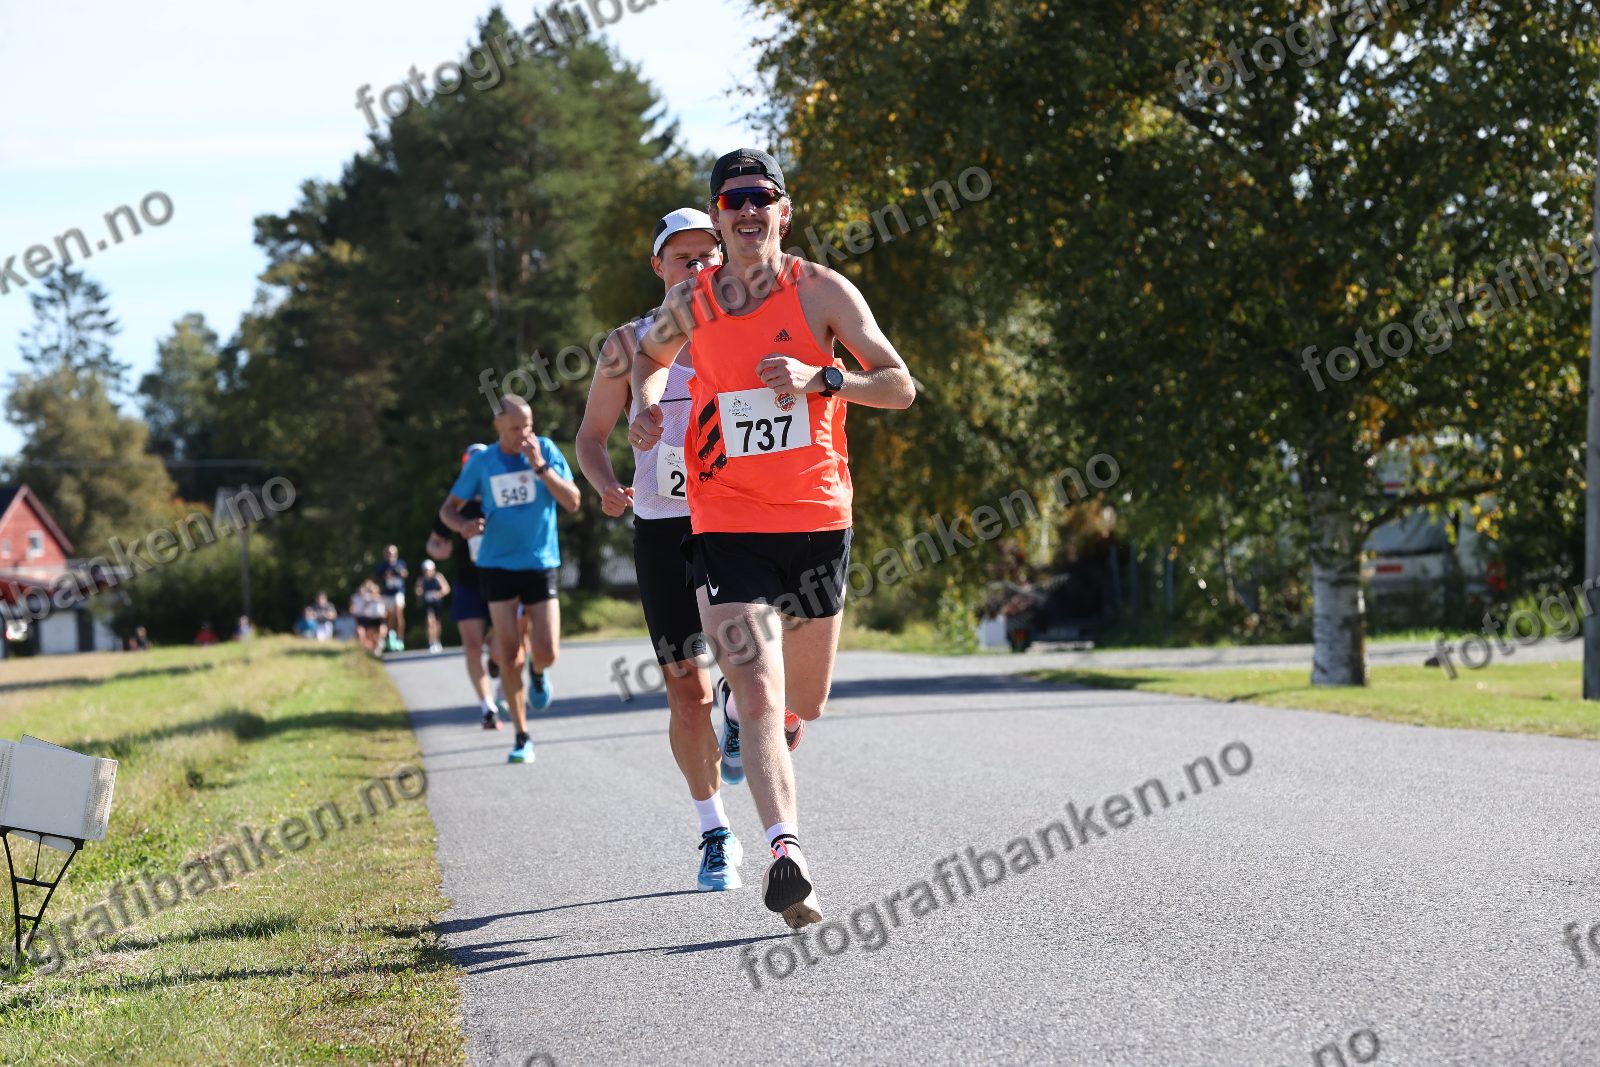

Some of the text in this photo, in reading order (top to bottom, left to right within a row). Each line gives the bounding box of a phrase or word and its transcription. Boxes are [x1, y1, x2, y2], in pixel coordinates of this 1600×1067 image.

[736, 415, 792, 452] 737
[501, 486, 528, 505] 549
[671, 471, 685, 497] 2
